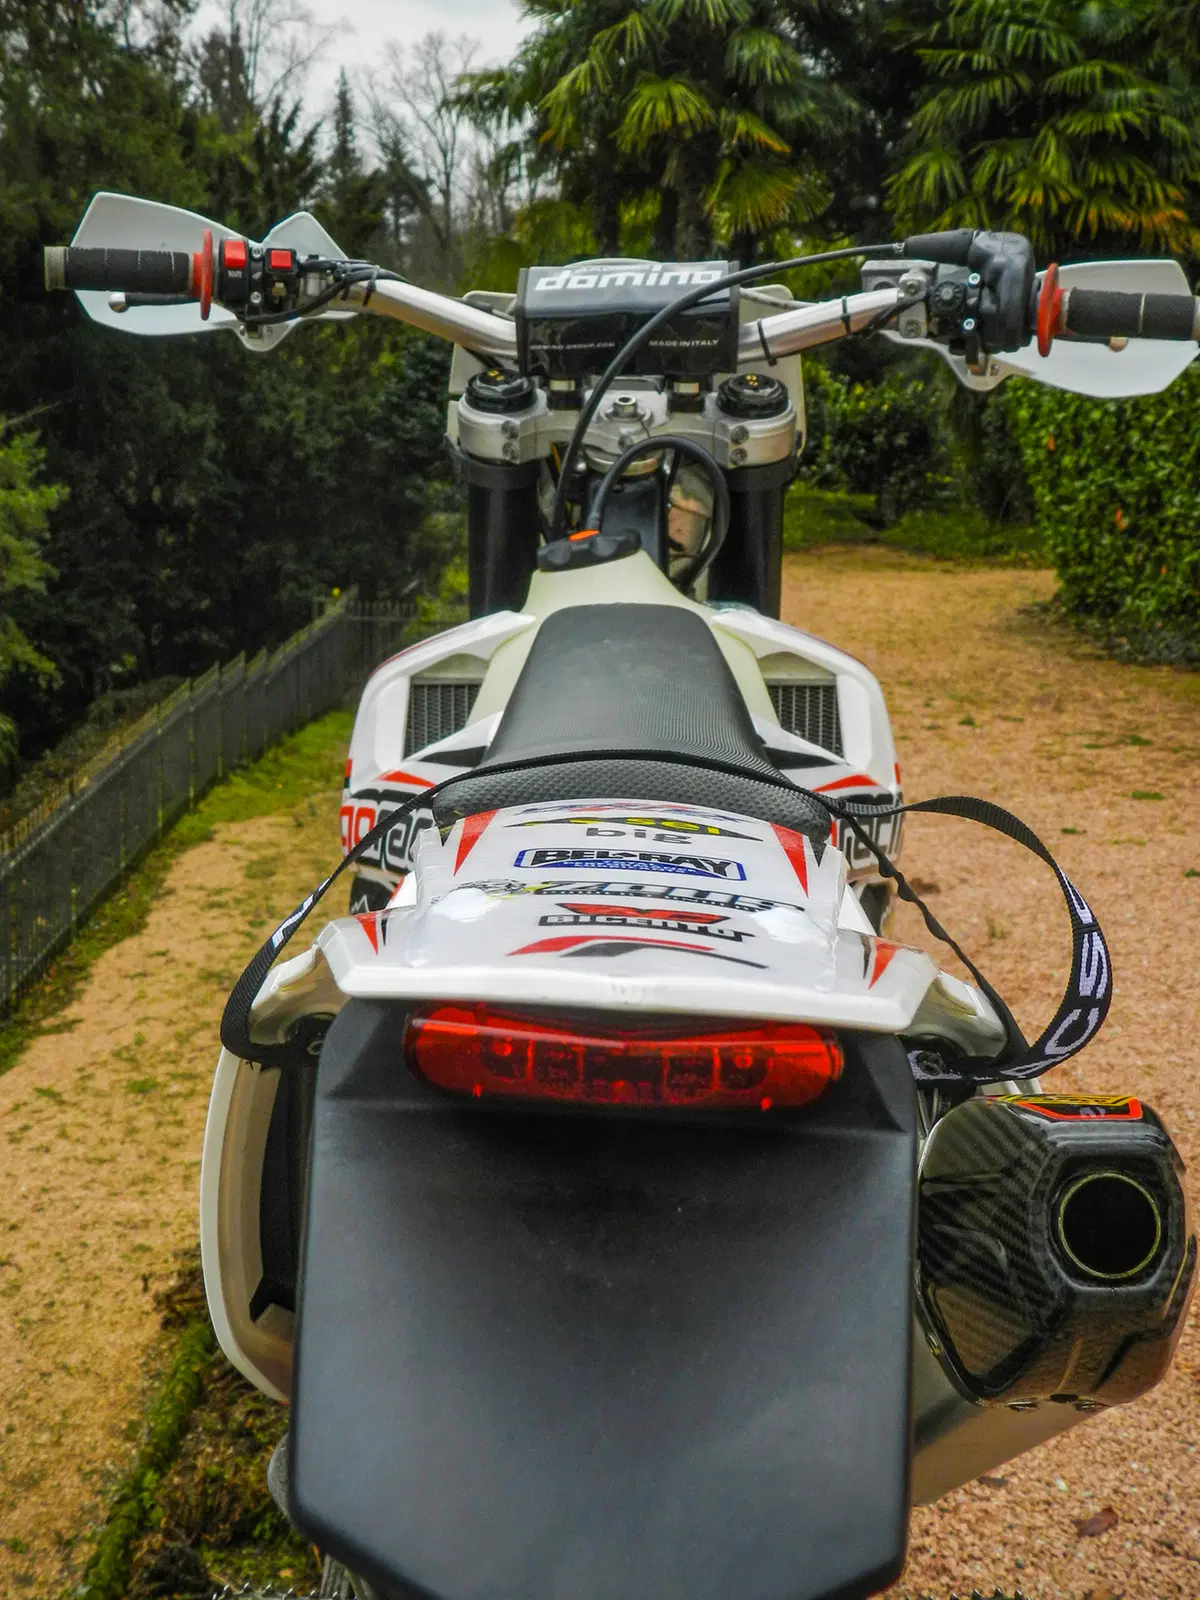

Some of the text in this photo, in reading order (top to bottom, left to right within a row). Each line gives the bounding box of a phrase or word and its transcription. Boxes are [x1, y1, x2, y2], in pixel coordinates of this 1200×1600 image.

[535, 264, 723, 291] domino
[648, 338, 720, 348] MADE IN ITALY
[585, 827, 693, 845] big
